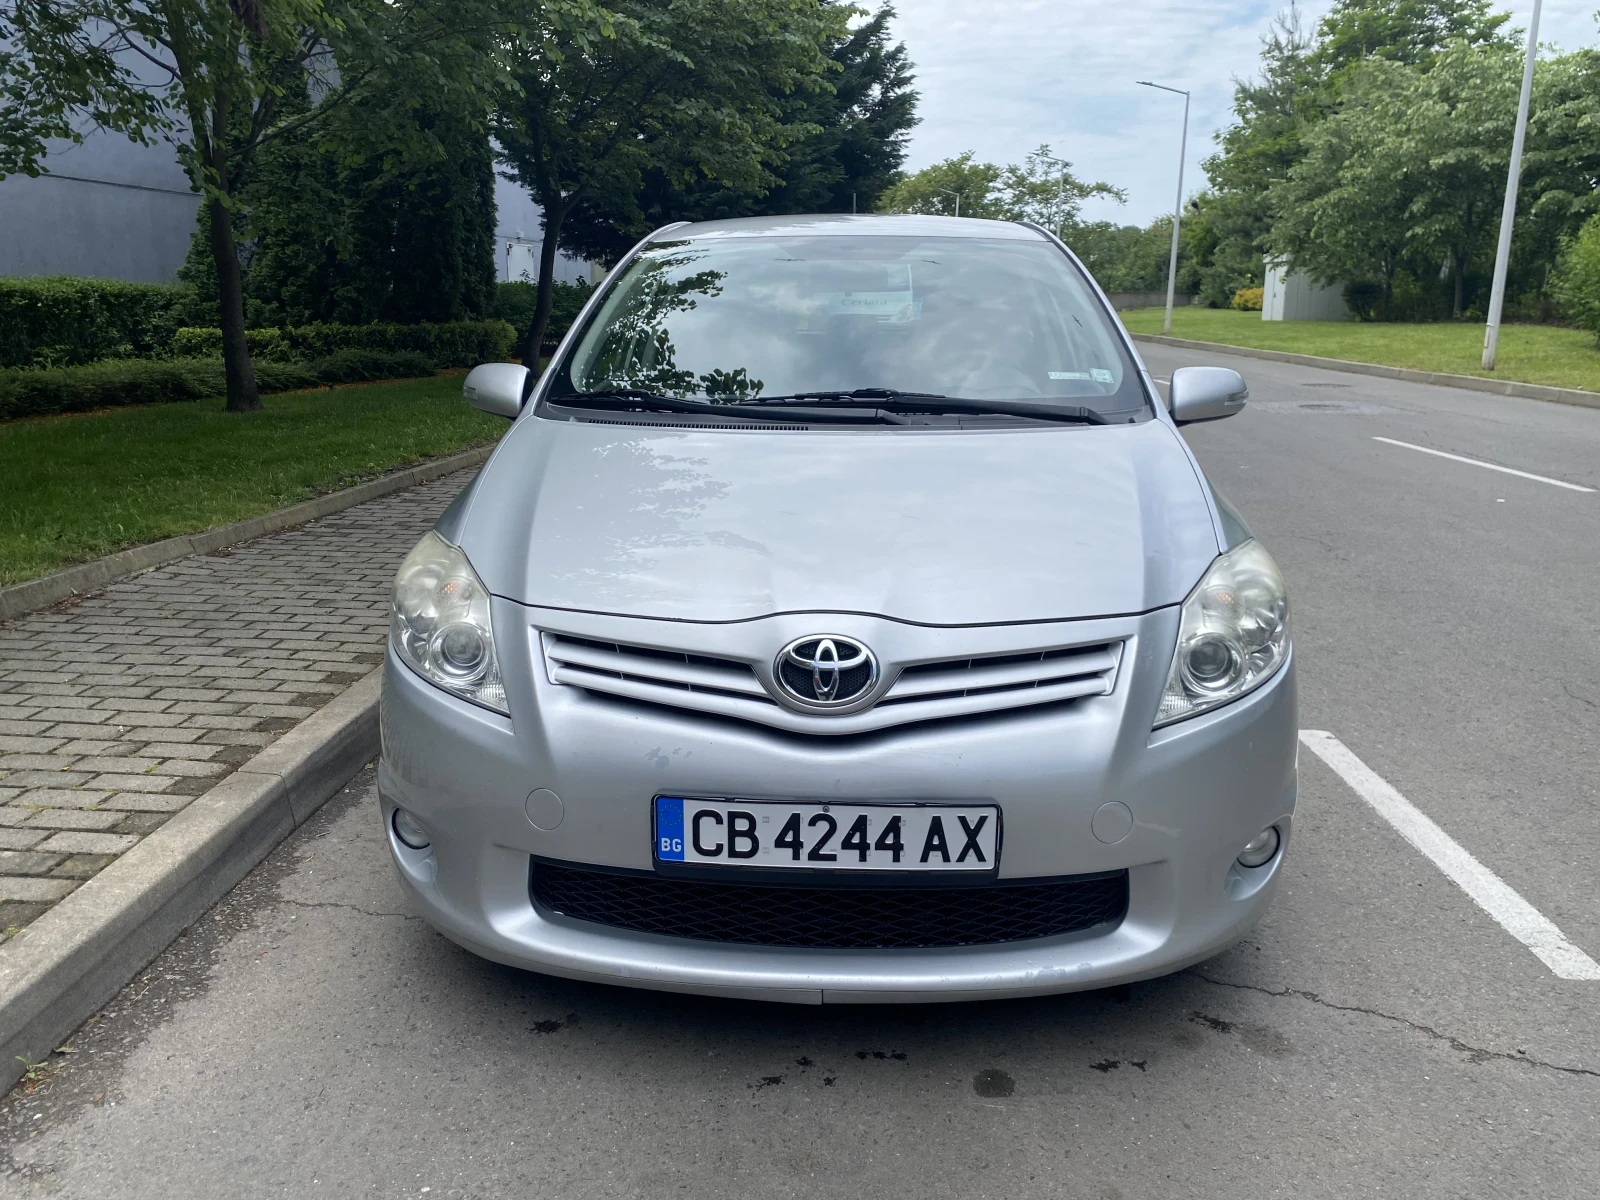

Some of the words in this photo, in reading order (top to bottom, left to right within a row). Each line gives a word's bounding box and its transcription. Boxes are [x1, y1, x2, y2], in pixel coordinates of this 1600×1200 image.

[661, 838, 682, 853] BG
[692, 809, 759, 859] CB
[774, 811, 904, 863] 4244
[919, 815, 989, 863] AX
